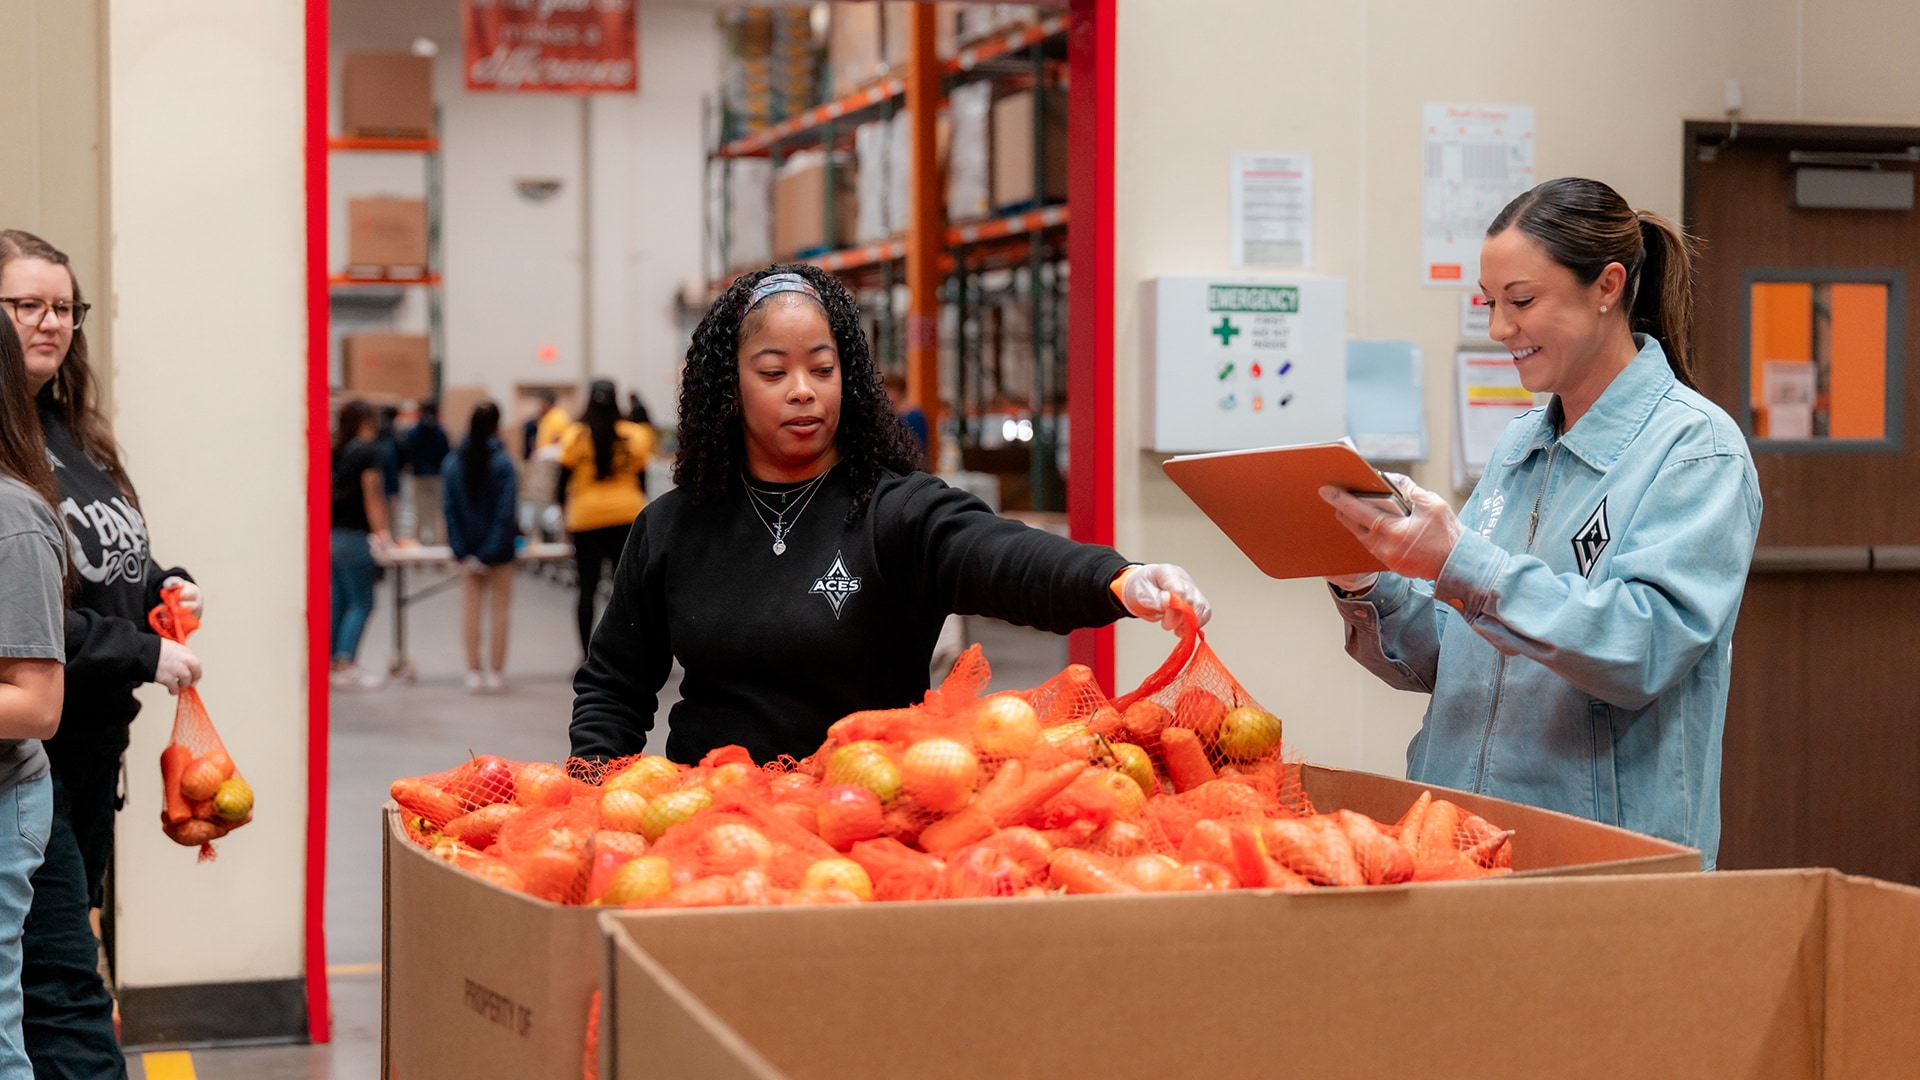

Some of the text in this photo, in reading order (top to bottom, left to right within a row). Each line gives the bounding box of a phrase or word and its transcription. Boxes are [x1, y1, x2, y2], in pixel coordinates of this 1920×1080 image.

[471, 46, 633, 88] difference
[1208, 287, 1297, 310] EMERGENCY
[812, 579, 860, 591] ACES
[464, 977, 533, 1038] PROPERTY OF
